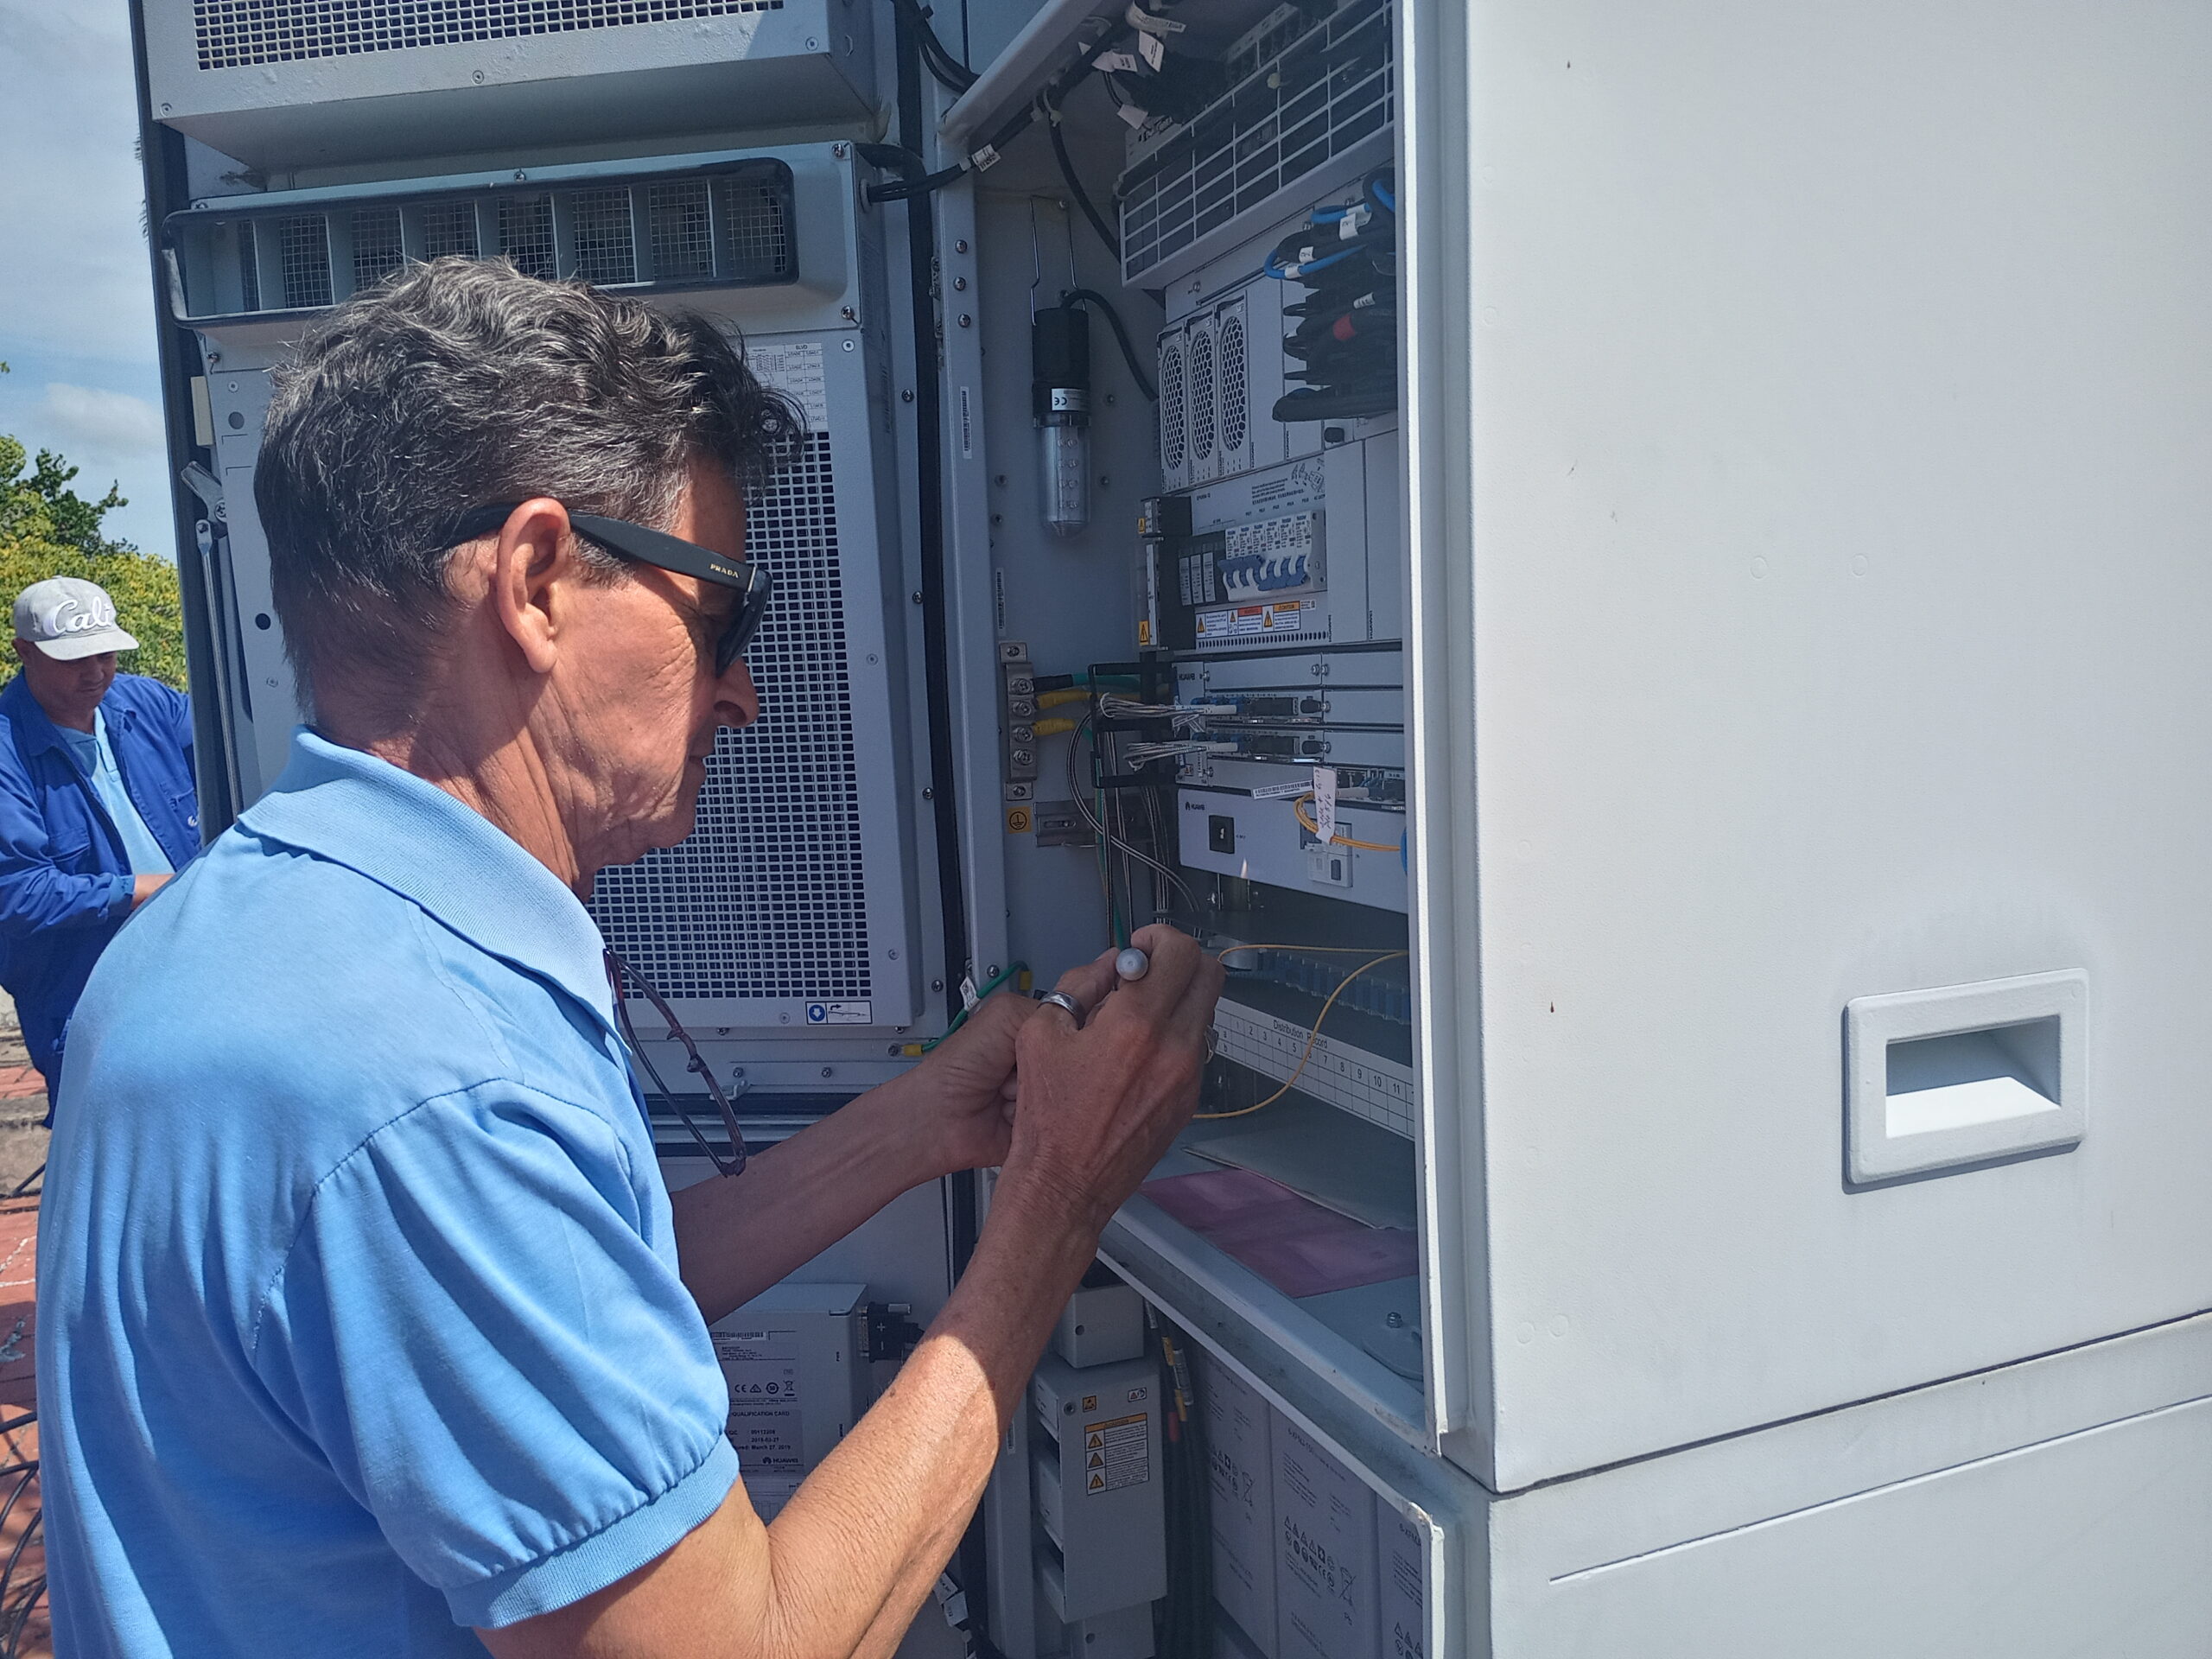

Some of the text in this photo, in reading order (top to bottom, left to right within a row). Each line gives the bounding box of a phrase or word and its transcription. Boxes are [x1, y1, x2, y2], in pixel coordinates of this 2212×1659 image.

[709, 563, 739, 578] PRADA
[53, 596, 112, 634] Cali
[1273, 1020, 1328, 1049] Distribution Rcord
[1249, 1026, 1253, 1035] 2
[1263, 1031, 1267, 1040] 3
[1277, 1038, 1281, 1046] 4
[1293, 1043, 1296, 1052] 5
[1324, 1055, 1327, 1065] 7
[1340, 1062, 1344, 1072] 8
[1357, 1068, 1362, 1079] 9
[1374, 1075, 1382, 1087] 10
[1392, 1084, 1400, 1094] 11
